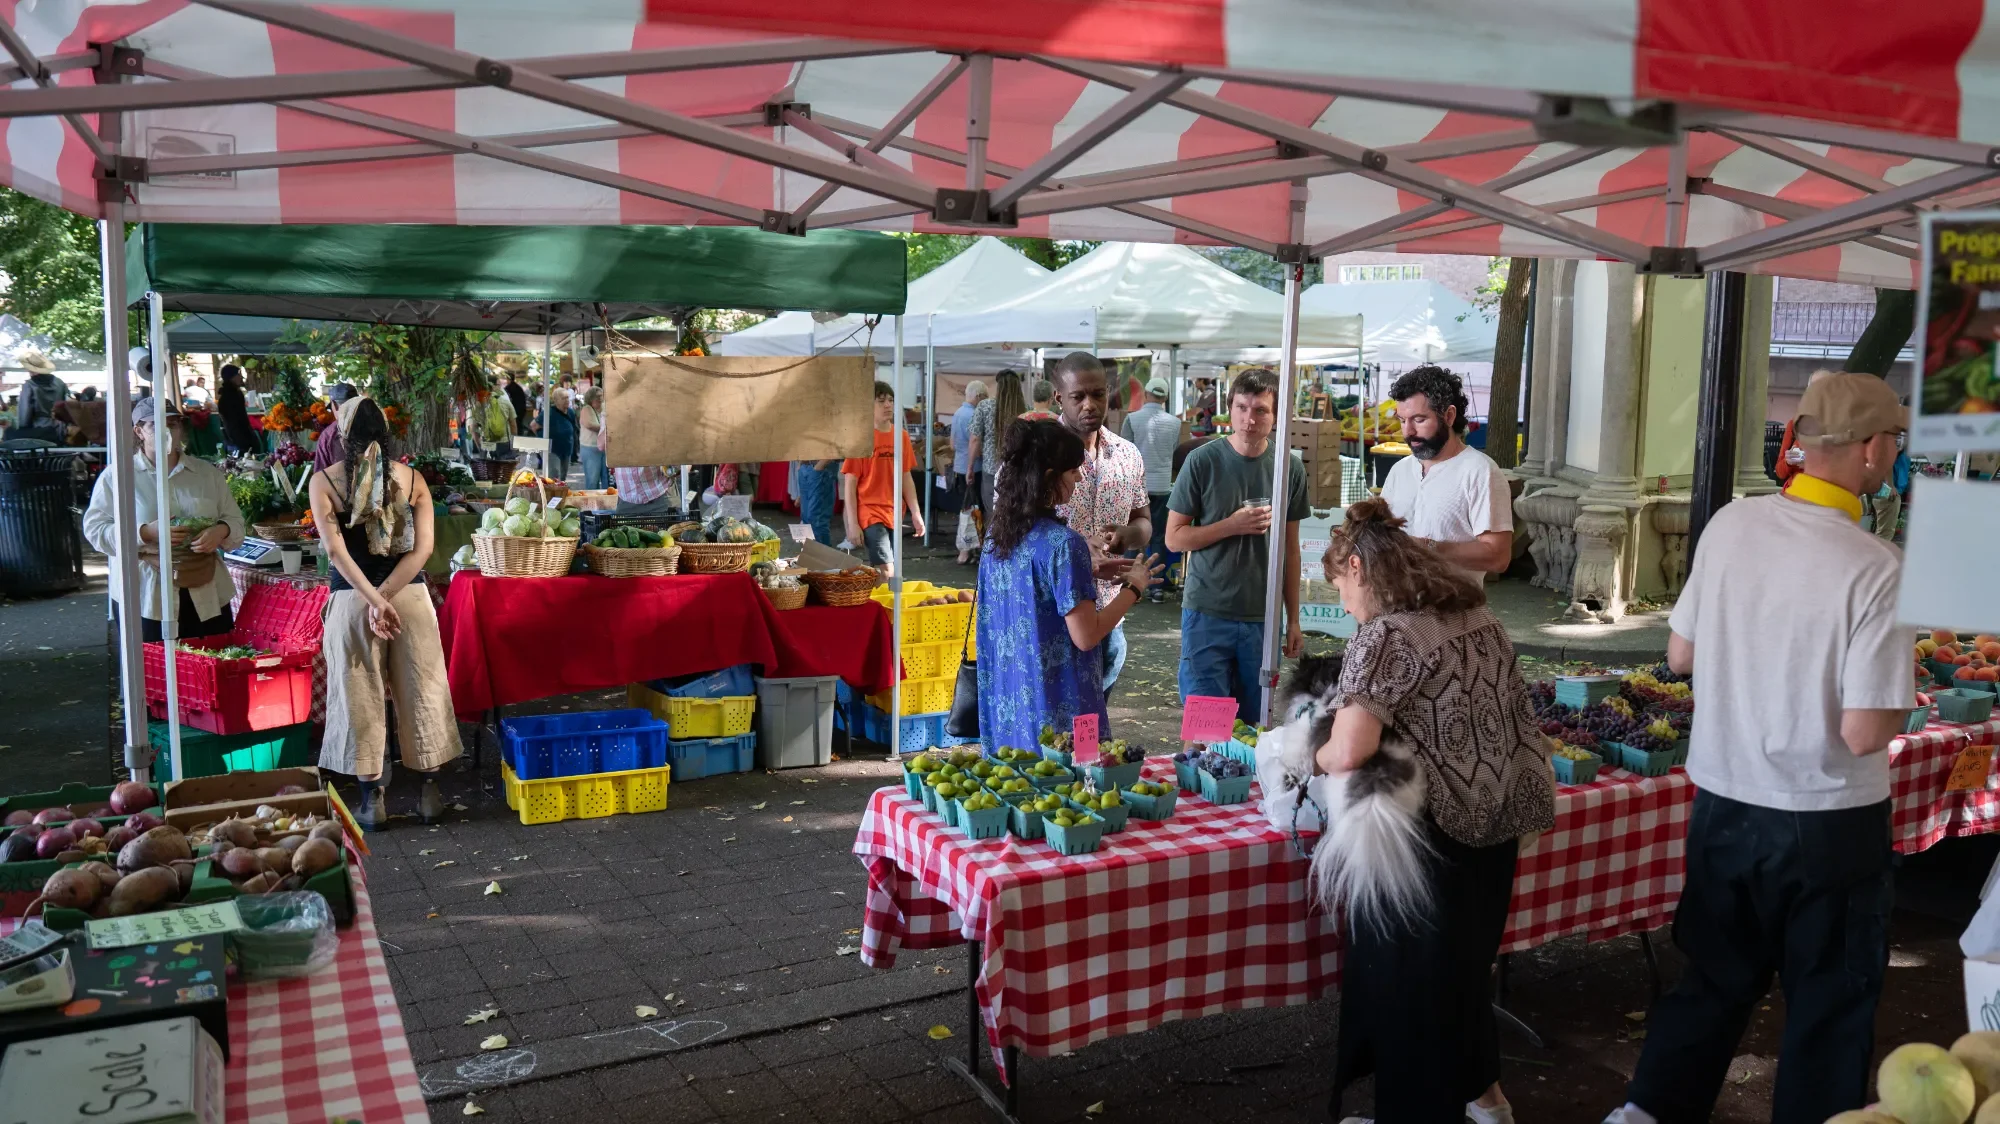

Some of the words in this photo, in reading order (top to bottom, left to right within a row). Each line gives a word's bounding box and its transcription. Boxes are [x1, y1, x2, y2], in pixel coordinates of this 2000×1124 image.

[1300, 605, 1346, 618] AIRD
[1074, 718, 1094, 728] Figs
[78, 1043, 158, 1116] Scale
